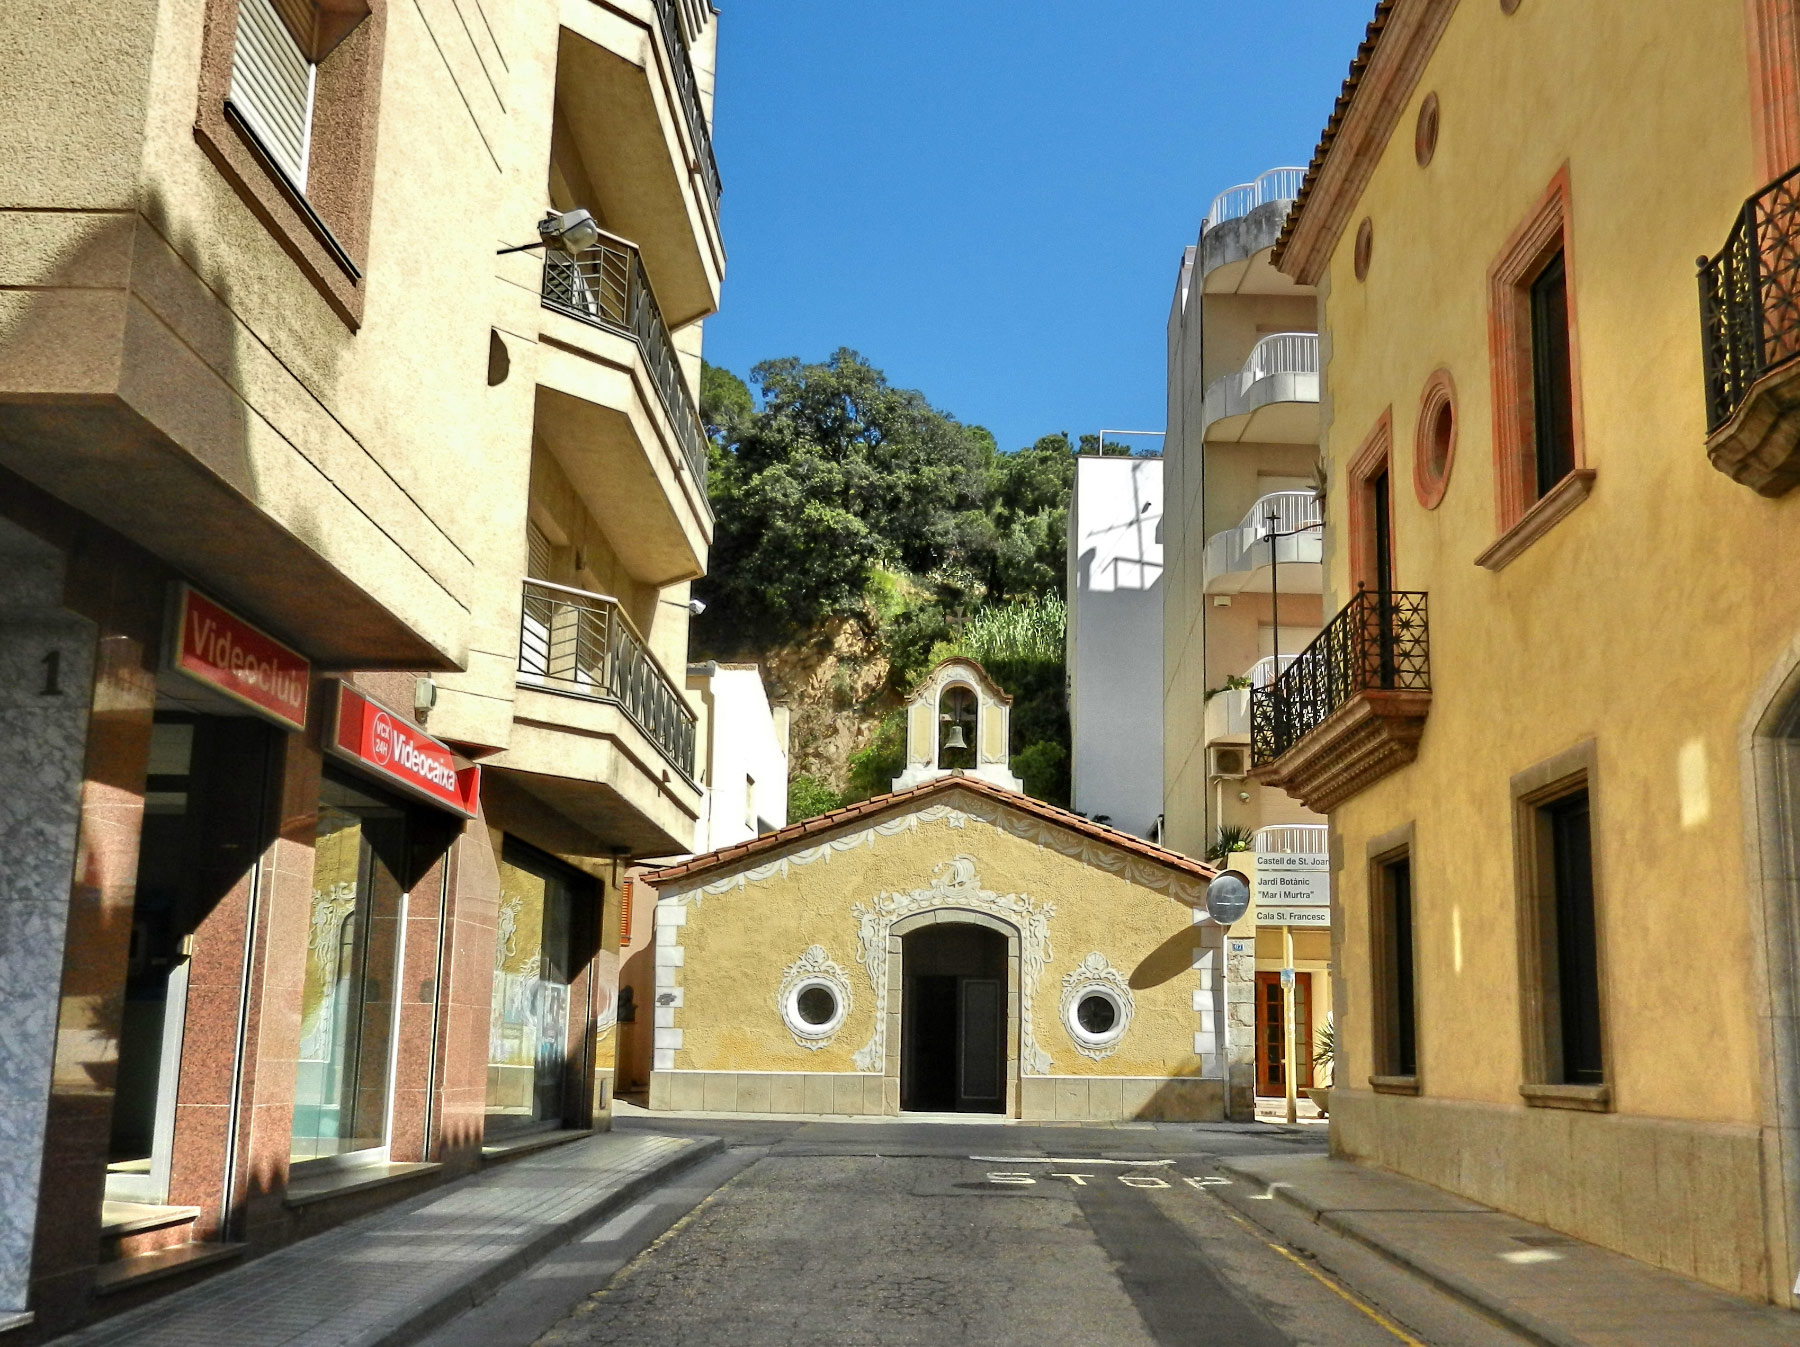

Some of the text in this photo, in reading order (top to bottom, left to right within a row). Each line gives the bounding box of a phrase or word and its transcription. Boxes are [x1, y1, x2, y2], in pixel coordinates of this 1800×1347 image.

[192, 610, 301, 708] Videoclub
[40, 650, 63, 696] 1
[376, 721, 390, 740] VCX
[376, 739, 389, 756] 24H
[393, 729, 456, 792] Videocaixa
[1257, 856, 1285, 865] Castell
[1286, 857, 1297, 865] de
[1298, 857, 1309, 866] St.
[1256, 911, 1326, 921] Cala St. Francesc
[986, 1172, 1233, 1190] STOP
